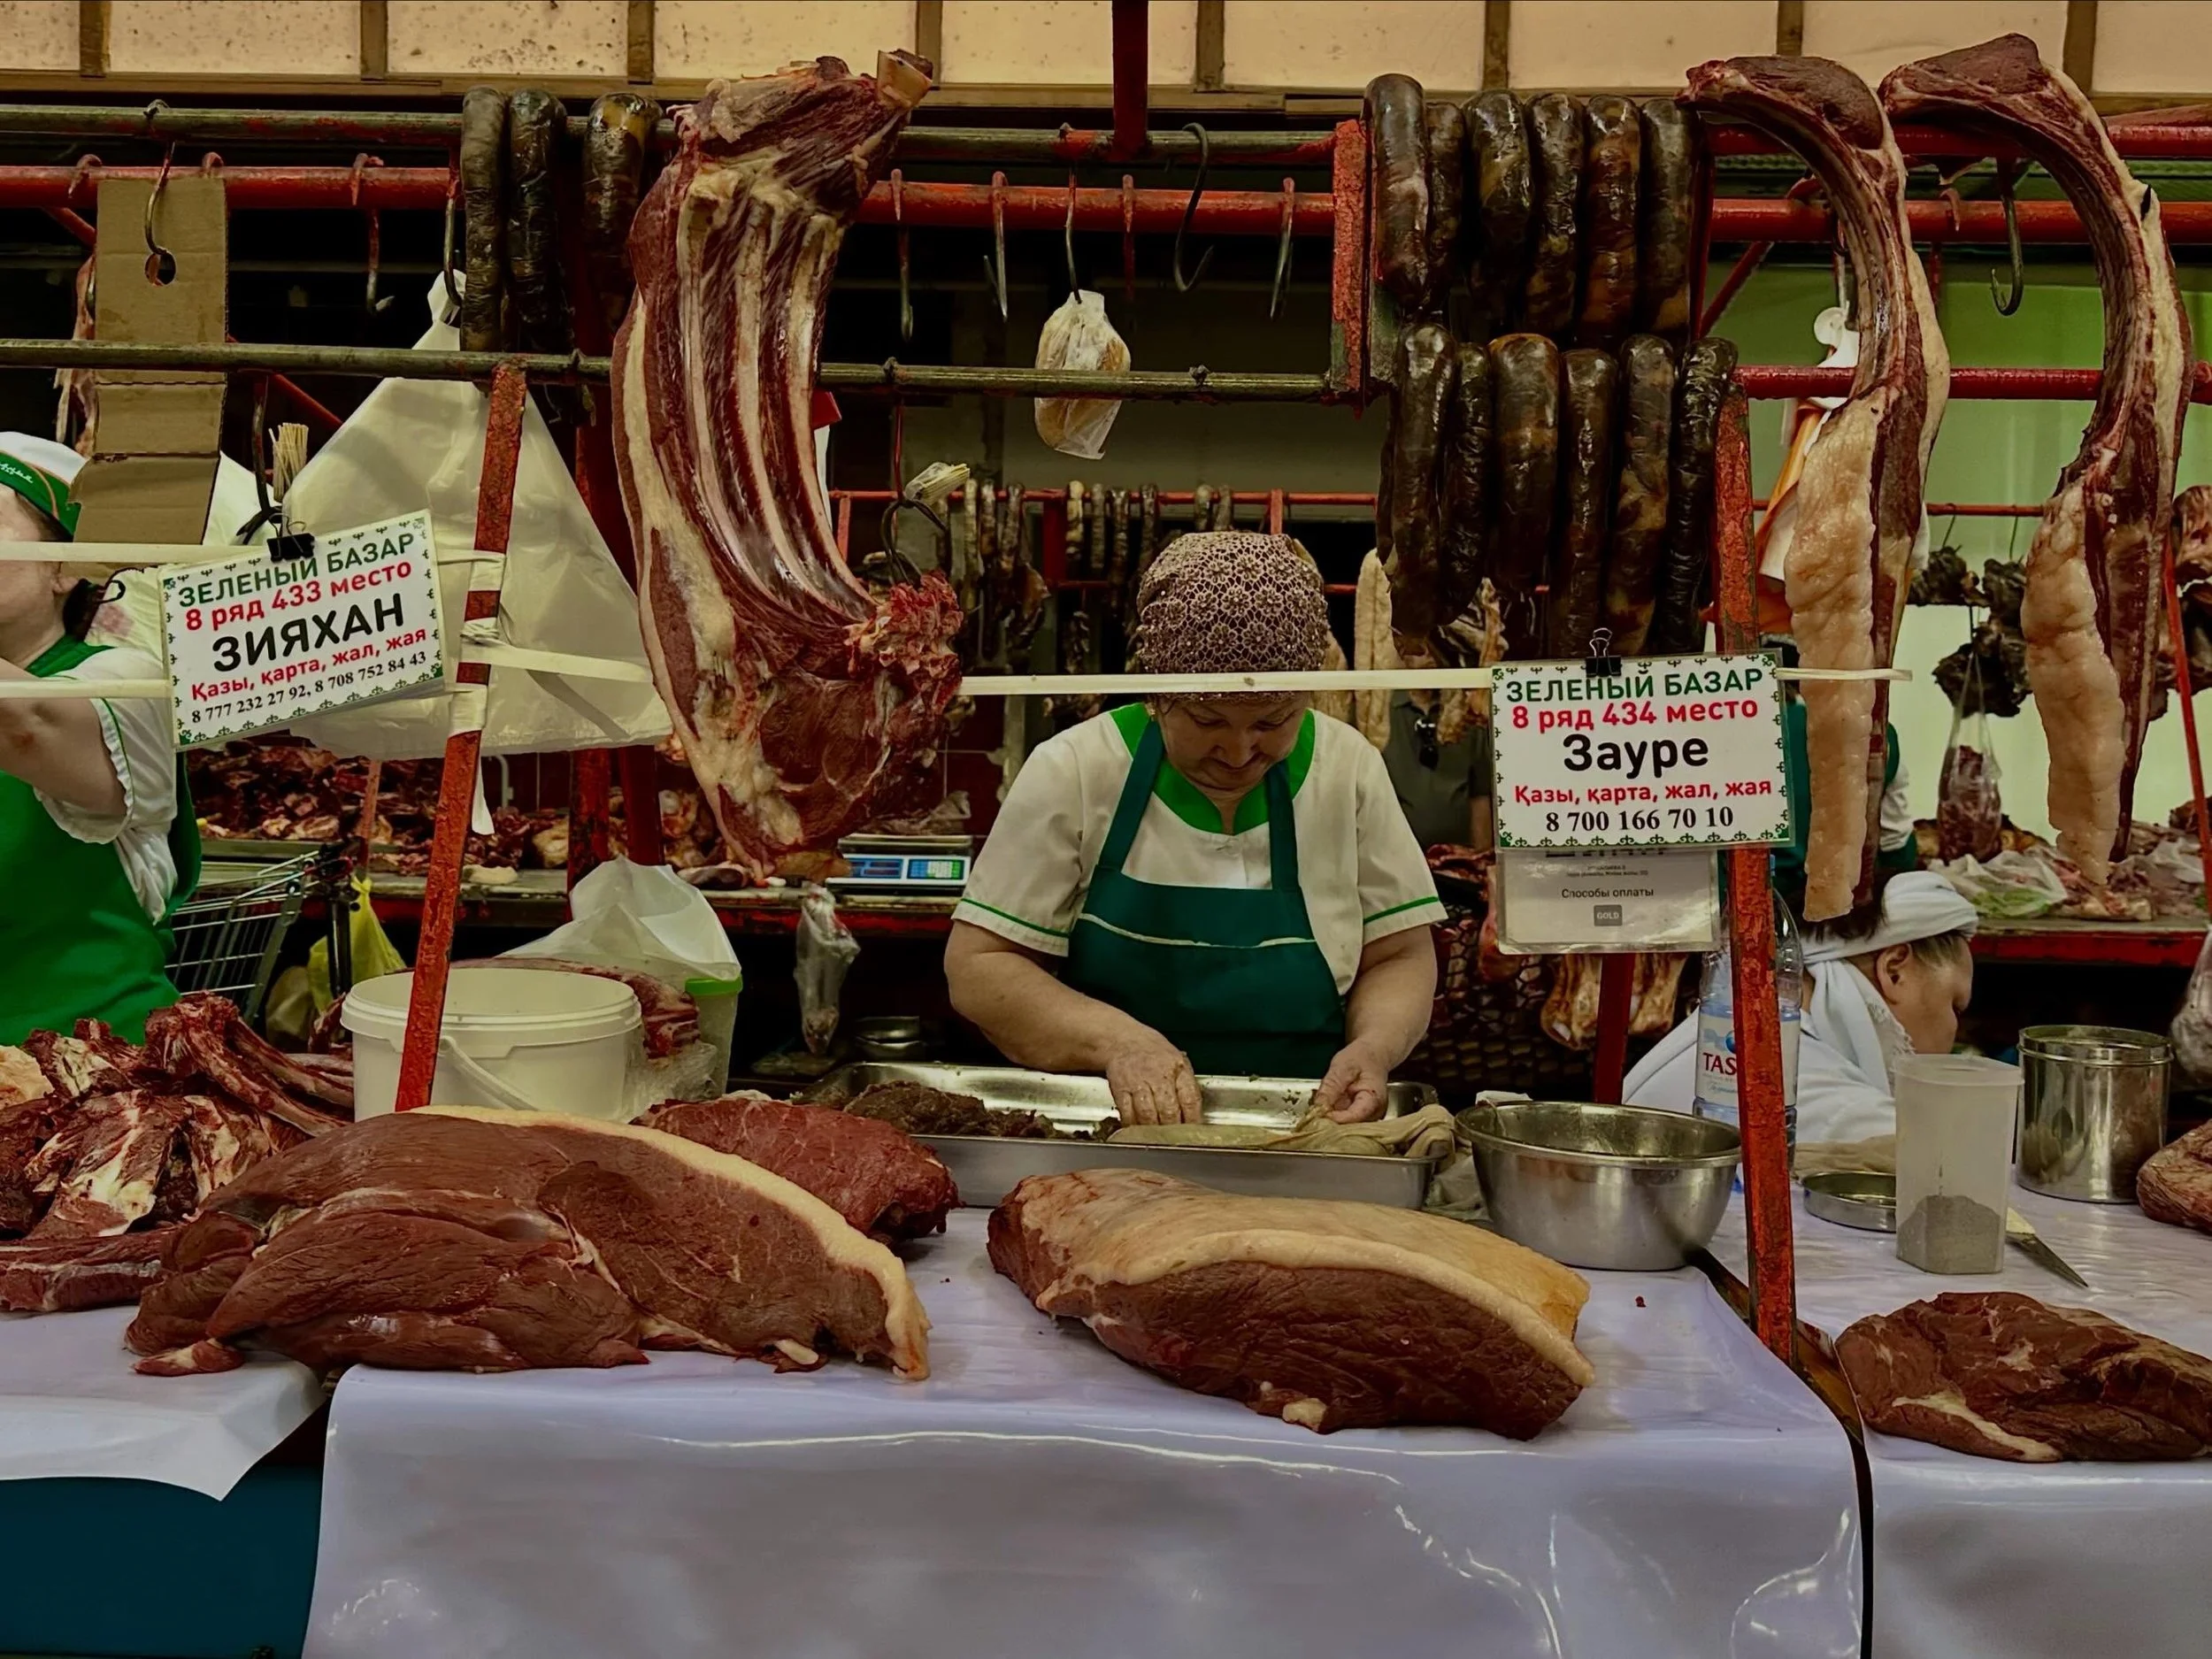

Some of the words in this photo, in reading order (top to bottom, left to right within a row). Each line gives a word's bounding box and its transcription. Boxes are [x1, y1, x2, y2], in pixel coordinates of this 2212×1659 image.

[326, 533, 414, 573] БАЗАР
[185, 609, 203, 632] 8
[211, 598, 265, 630] ряд
[272, 580, 322, 611] 433
[330, 561, 412, 597] место
[211, 593, 404, 672] ЗИЯХАН
[191, 675, 256, 703] Қазы,
[261, 657, 327, 686] қарта,
[332, 642, 381, 668] жал,
[387, 628, 426, 653] жая
[191, 710, 202, 724] 8
[204, 703, 232, 721] 777
[236, 695, 263, 714] 232
[267, 690, 285, 707] 27
[288, 683, 312, 705] 92,
[314, 679, 325, 693] 8
[328, 671, 355, 690] 708
[357, 664, 384, 682] 752
[387, 657, 406, 673] 84
[409, 651, 426, 668] 43
[1506, 668, 1655, 703] ЗЕЛЕНЫЙ
[1664, 668, 1763, 696] БАЗАР
[1511, 705, 1529, 729] 8
[1539, 707, 1595, 733] ряд
[1602, 702, 1657, 726] 434
[1666, 699, 1759, 723] место
[1563, 733, 1709, 780] Зауре
[1514, 785, 1580, 807] Қазы,
[1587, 785, 1659, 806] қарта,
[1664, 781, 1719, 801] жал,
[1724, 780, 1772, 796] жая
[1545, 811, 1560, 832] 8
[1567, 810, 1610, 832] 700
[1618, 810, 1661, 831] 166
[1667, 808, 1697, 829] 70
[1707, 806, 1734, 827] 10
[1561, 887, 1610, 900] Способы
[1612, 887, 1655, 899] оплаты
[1702, 1052, 1737, 1076] TAS
